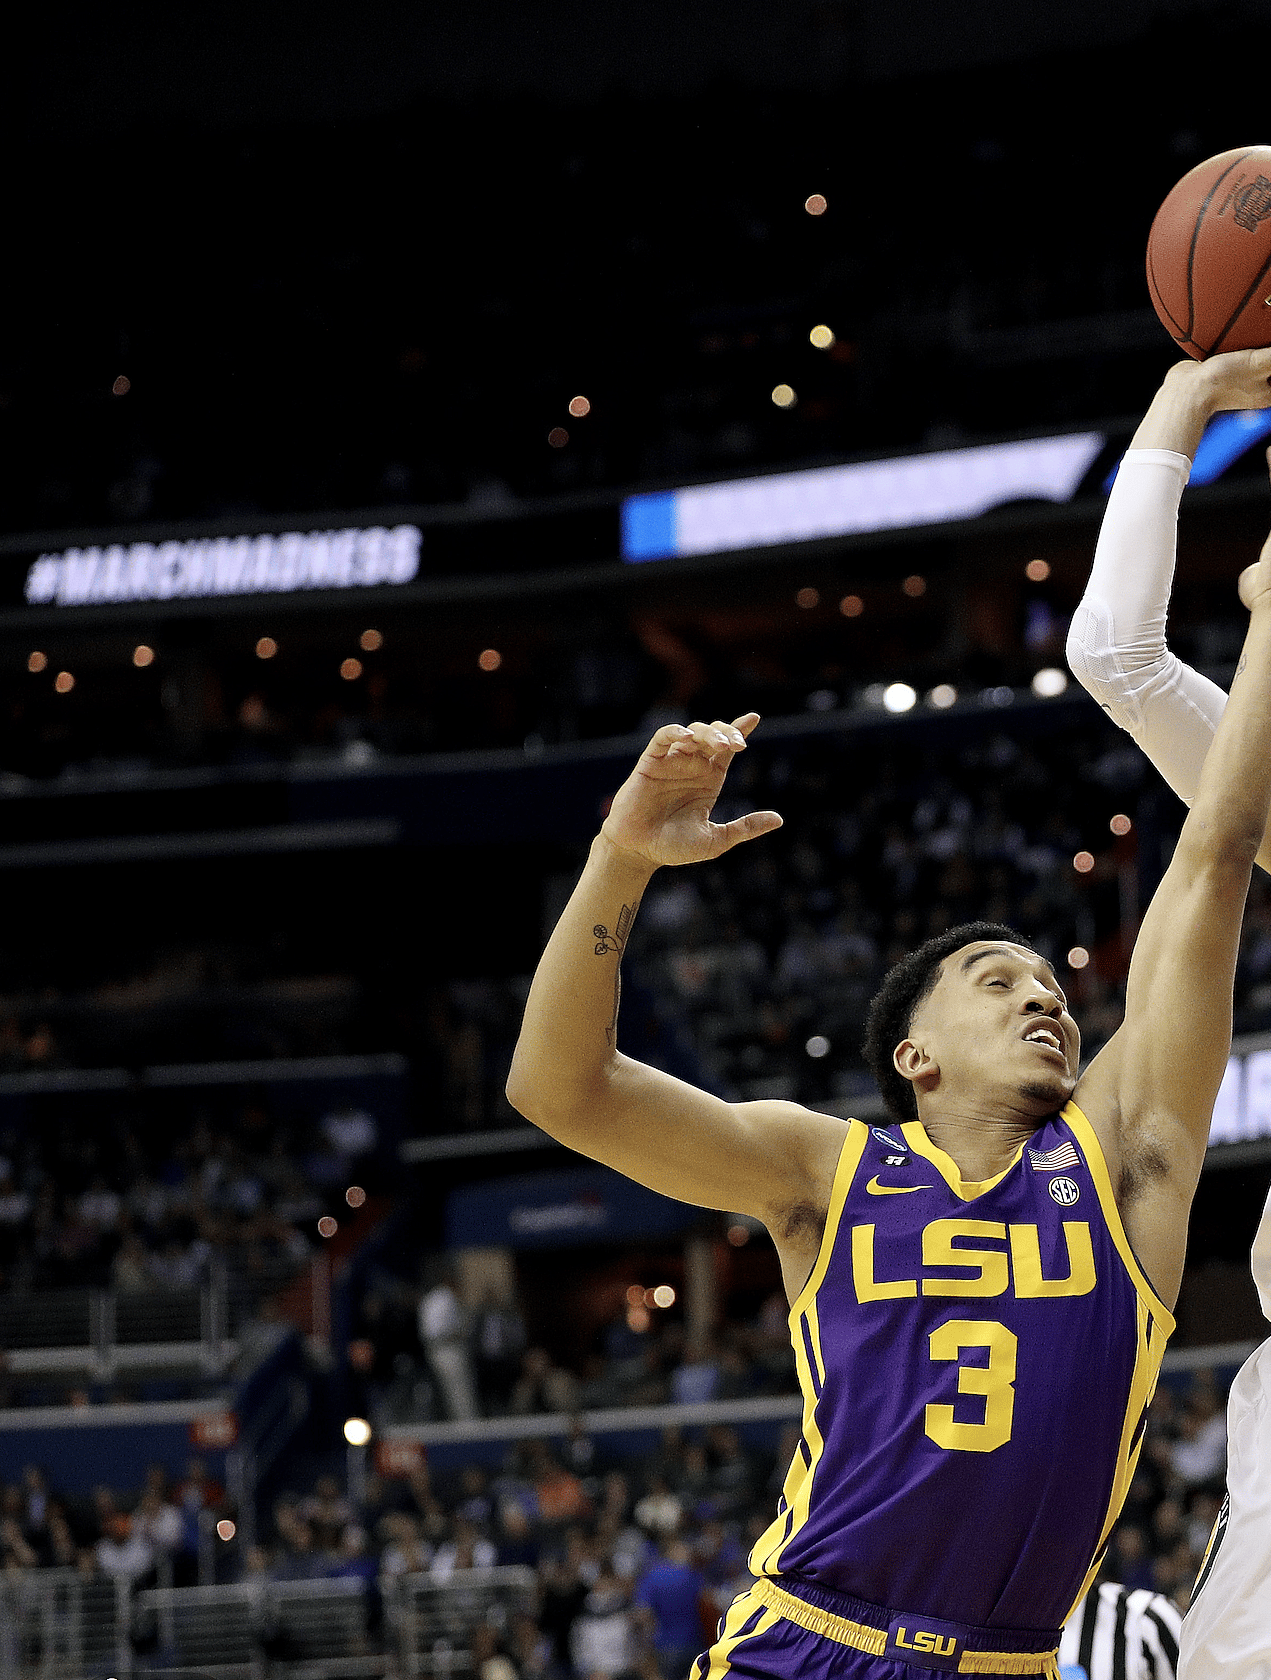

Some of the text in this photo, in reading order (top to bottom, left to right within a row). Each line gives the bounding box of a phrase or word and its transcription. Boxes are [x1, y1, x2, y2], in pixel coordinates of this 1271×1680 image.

[1051, 1182, 1079, 1204] SEC
[851, 1219, 1097, 1304] LSU
[925, 1320, 1018, 1453] 3
[894, 1626, 958, 1657] LSU
